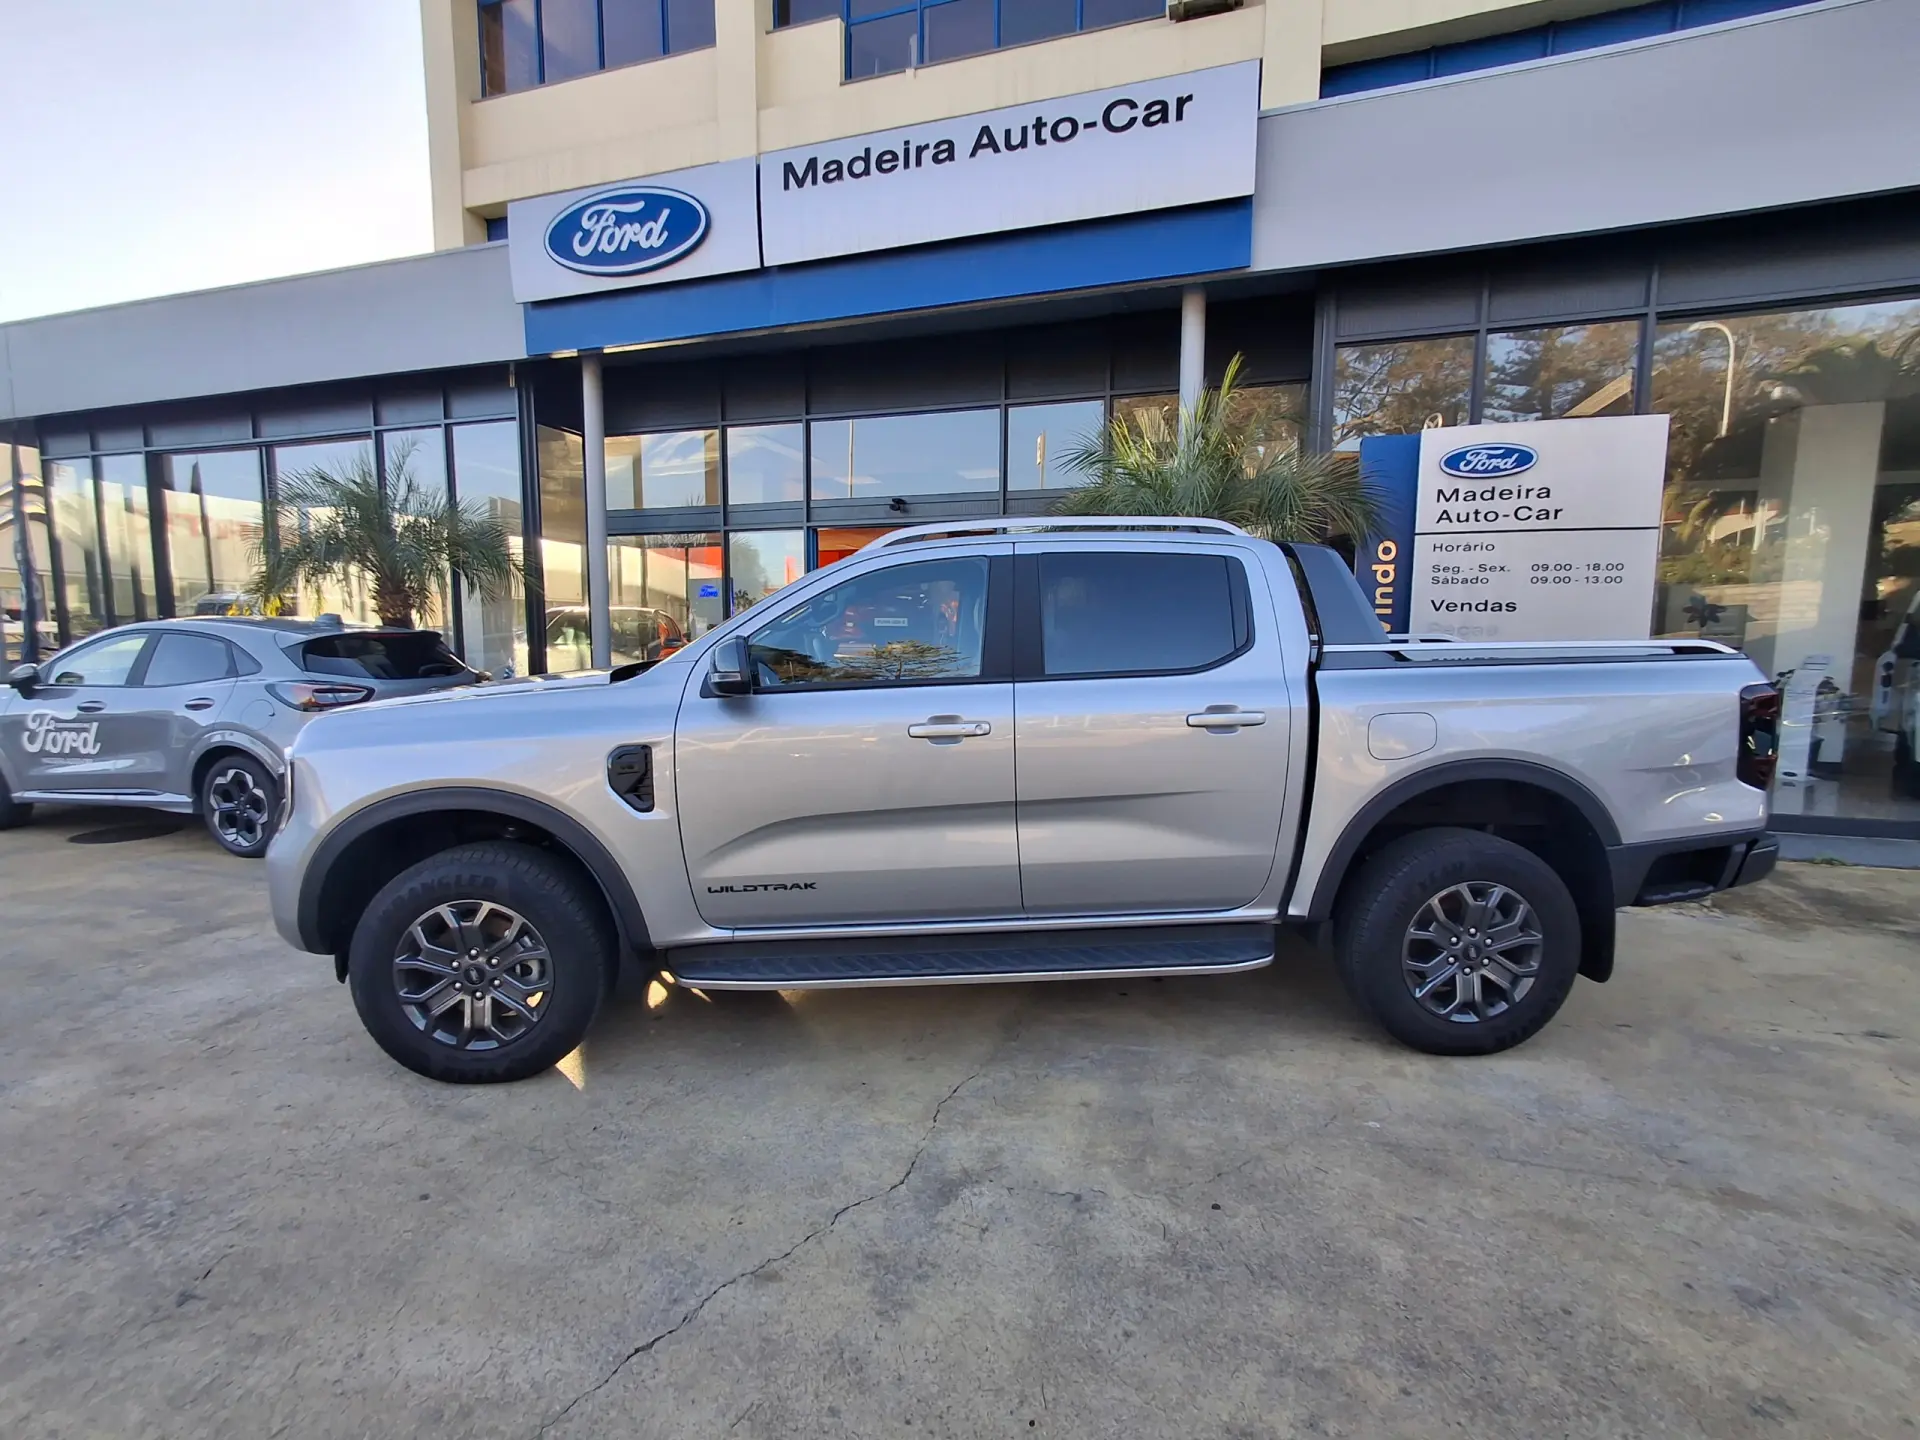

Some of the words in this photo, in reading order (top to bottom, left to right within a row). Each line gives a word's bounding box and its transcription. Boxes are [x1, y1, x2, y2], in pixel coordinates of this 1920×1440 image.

[781, 137, 956, 192] Madeira
[968, 93, 1194, 159] Auto-Car
[572, 199, 671, 257] Ford
[1459, 448, 1521, 472] Ford
[1436, 484, 1552, 504] Madeira
[1435, 505, 1564, 524] Auto-Car
[1432, 541, 1496, 553] Horário
[1431, 564, 1465, 575] Seg.
[1478, 563, 1511, 573] Sex.
[1531, 563, 1573, 572] 09.00
[1584, 562, 1625, 572] 18.00
[1430, 575, 1490, 585] Sábado
[1530, 575, 1572, 585] 09.00
[1583, 575, 1623, 584] 13.00
[1429, 599, 1518, 613] Vendas
[22, 708, 102, 755] Ford
[707, 881, 818, 894] WILDTRAK
